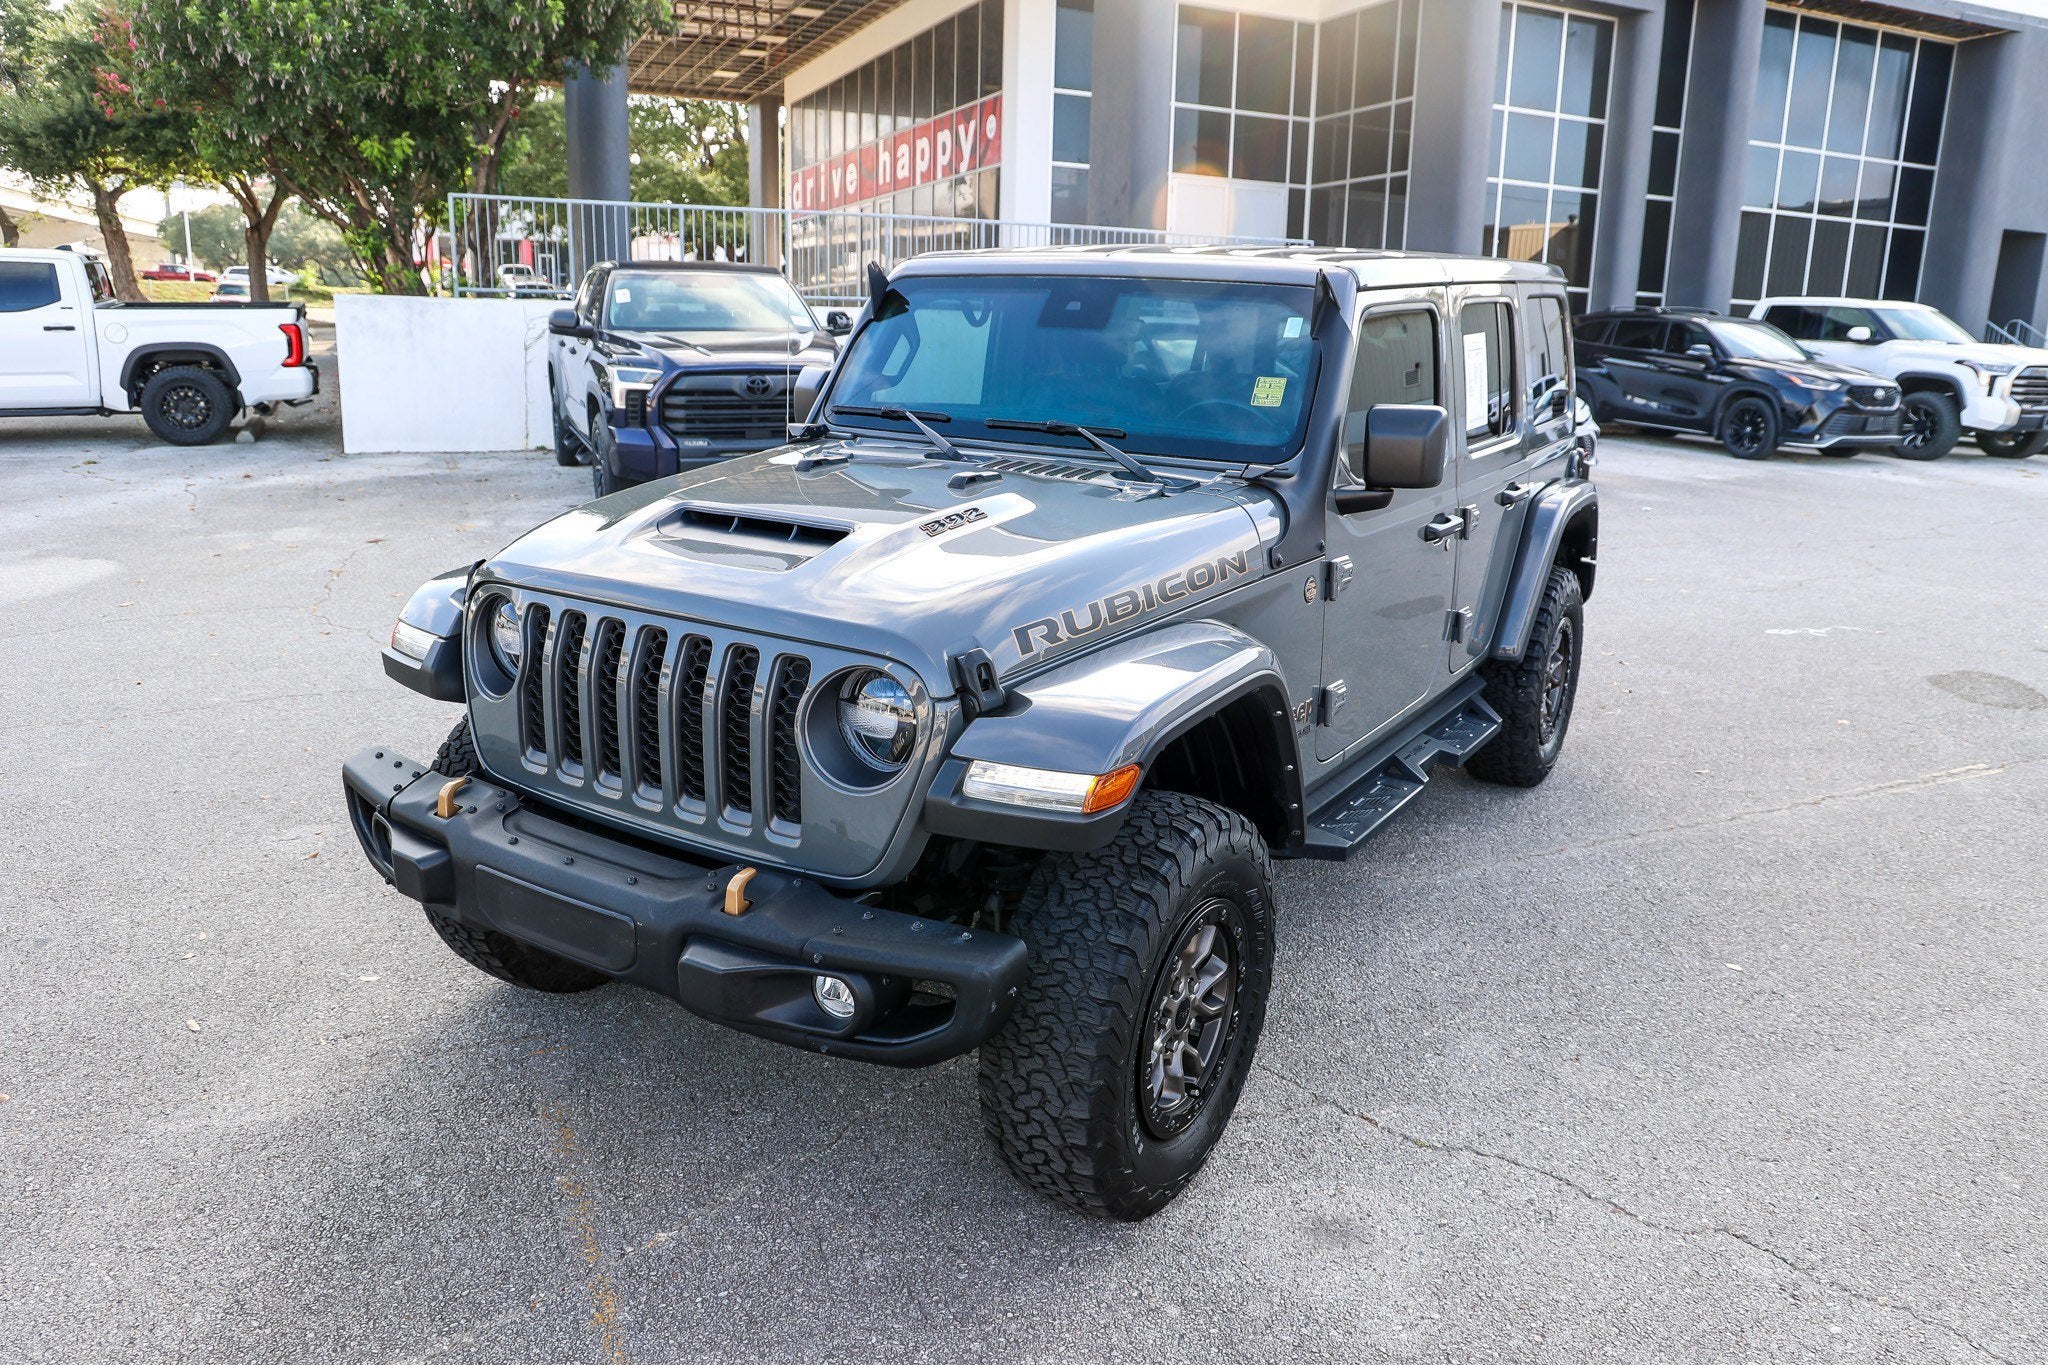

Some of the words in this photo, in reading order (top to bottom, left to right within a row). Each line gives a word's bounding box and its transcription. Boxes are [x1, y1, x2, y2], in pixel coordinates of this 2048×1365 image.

[792, 162, 858, 210] drive
[919, 507, 988, 537] 392
[1012, 549, 1251, 656] RUBICON
